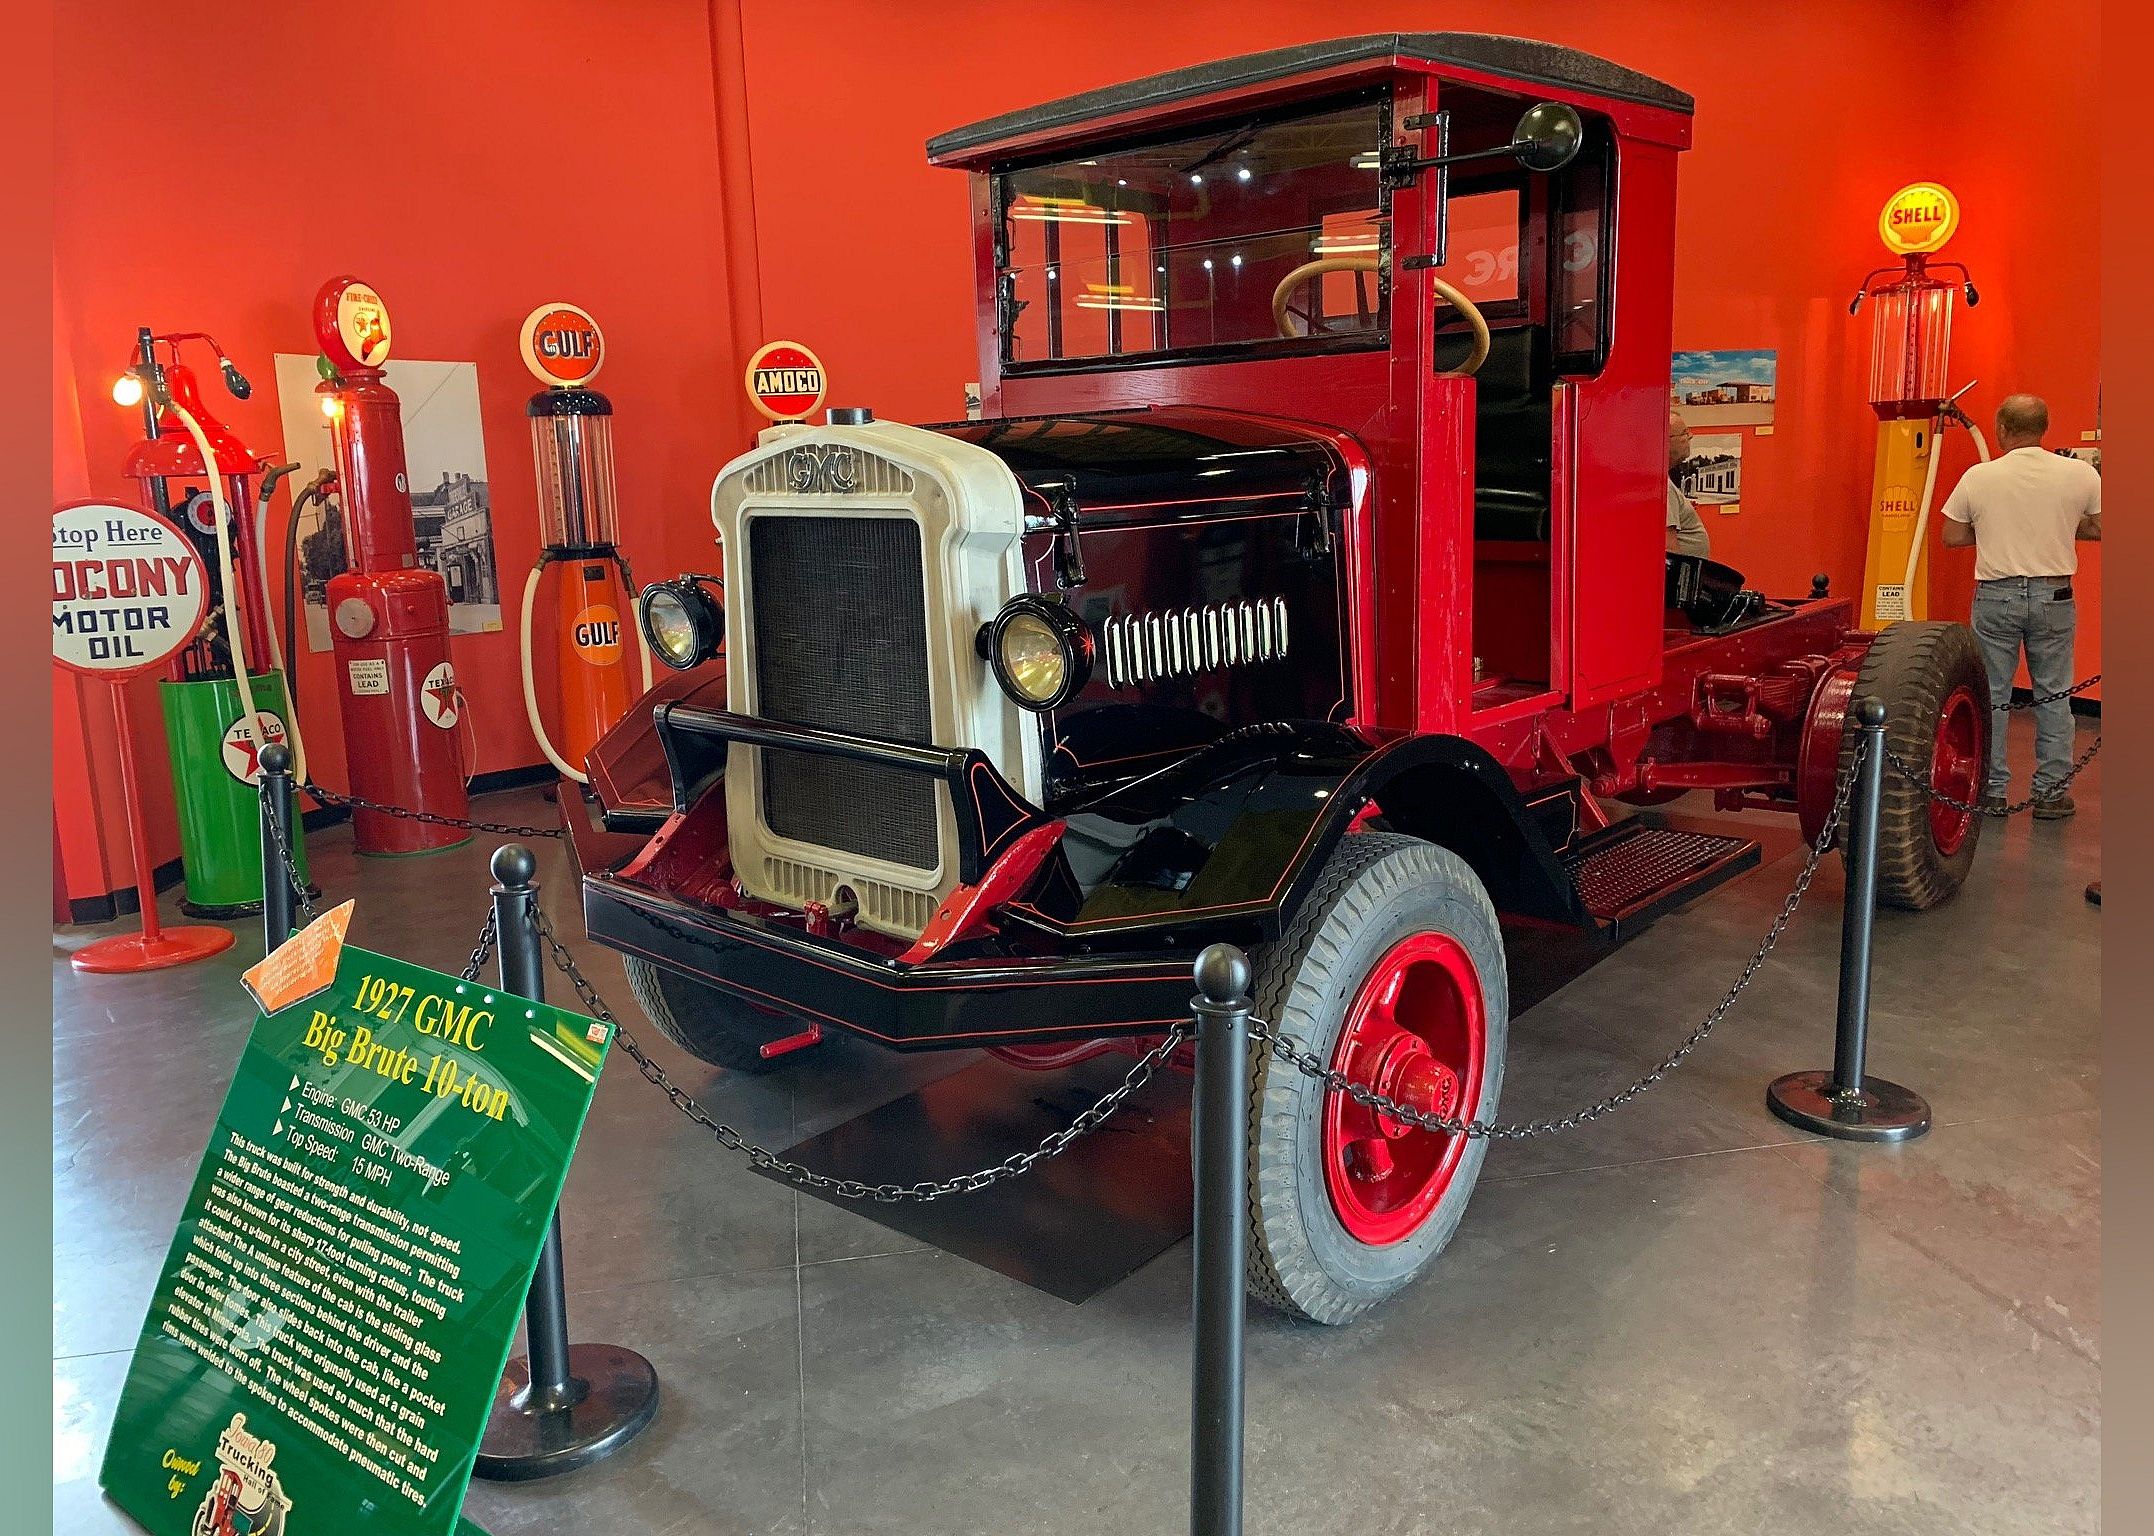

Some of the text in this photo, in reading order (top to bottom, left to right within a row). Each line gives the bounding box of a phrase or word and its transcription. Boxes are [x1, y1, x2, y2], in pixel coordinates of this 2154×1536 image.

[1893, 206, 1941, 224] SHELL
[541, 330, 593, 358] GULF
[757, 371, 819, 393] AMOCO
[789, 451, 855, 493] GMC
[105, 520, 162, 542] Here
[1880, 500, 1915, 512] SHELL
[53, 606, 171, 634] MOTOR
[575, 621, 620, 648] GULF
[88, 635, 144, 660] OIL
[353, 672, 382, 680] CONTAINS
[358, 680, 379, 688] LEAD
[234, 724, 280, 739] TEACO
[352, 974, 495, 1051] 1927 GMC
[301, 1010, 509, 1122] Big Brute 10-ton
[301, 1081, 400, 1133] Engine: GMC 53 HP
[287, 1125, 393, 1187] Top Speed: 15 MPH
[296, 1103, 450, 1187] Transmission GMC Two-Range
[223, 1148, 461, 1280] The Big Brute boasted a two-range transmission permitting
[230, 1131, 461, 1255] This truck was built for strength and durability, not speed.
[211, 1183, 447, 1320] was also known for its sharp 17-foot turning radius, touting
[216, 1167, 465, 1303] a wider range of gear reductions for pulling power. The truck
[198, 1218, 442, 1363] attached! The A unique feature of the cab is the sliding glass
[211, 1205, 233, 1222] could
[232, 1214, 242, 1228] do
[242, 1222, 249, 1232] a
[248, 1225, 272, 1245] u-turn
[271, 1235, 280, 1250] in
[280, 1243, 287, 1253] a
[287, 1246, 304, 1264] city
[303, 1256, 331, 1281] street,
[332, 1272, 354, 1291] even
[355, 1284, 375, 1303] with
[376, 1294, 392, 1311] the
[393, 1303, 424, 1328] trailer
[193, 1235, 429, 1380] which folds up into three sections behind the driver and the
[185, 1252, 446, 1417] passenger. The door also slides back into the cab, like a pocket
[162, 1320, 427, 1509] rims were welded to the spokes to accommodate pneumatic tires.
[168, 1304, 428, 1481] rubber tires were worn off. The wheel spokes were then cut and
[162, 1449, 201, 1477] Owned
[168, 1474, 186, 1499] by:
[219, 1437, 274, 1488] Trucking
[243, 1474, 285, 1511] Hall of Fame
